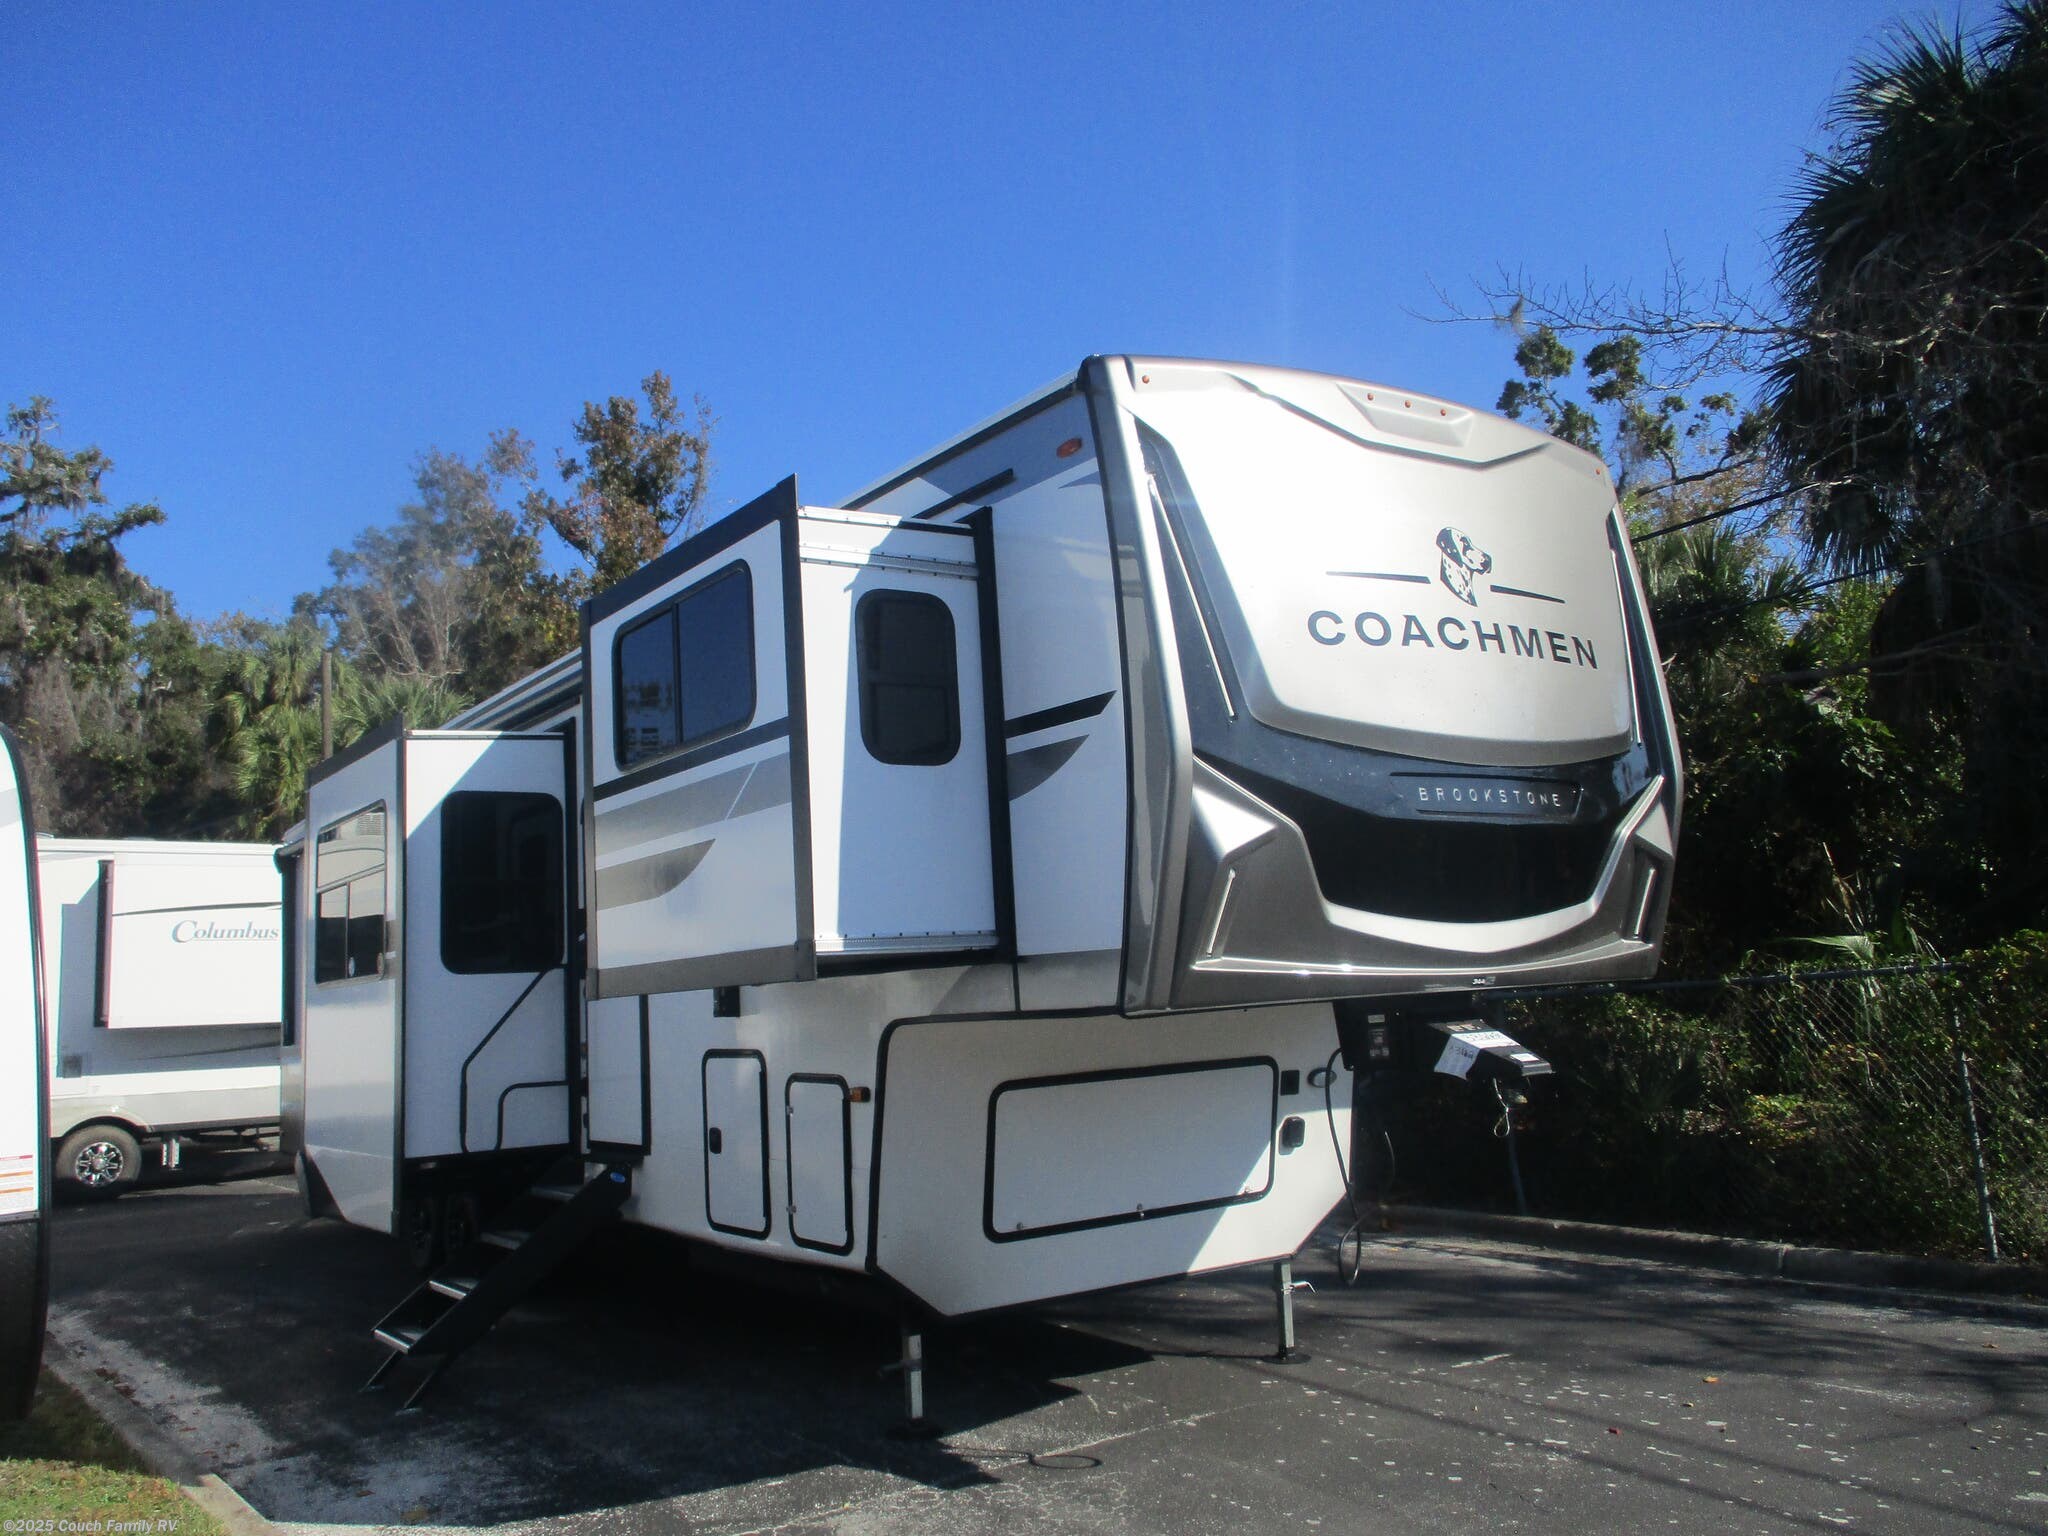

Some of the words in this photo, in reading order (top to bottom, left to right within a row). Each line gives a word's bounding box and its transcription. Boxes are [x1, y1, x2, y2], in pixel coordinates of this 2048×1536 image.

[1307, 609, 1598, 669] COACHMEN
[1418, 786, 1562, 807] BROOKSTONE
[171, 919, 279, 943] Columbus
